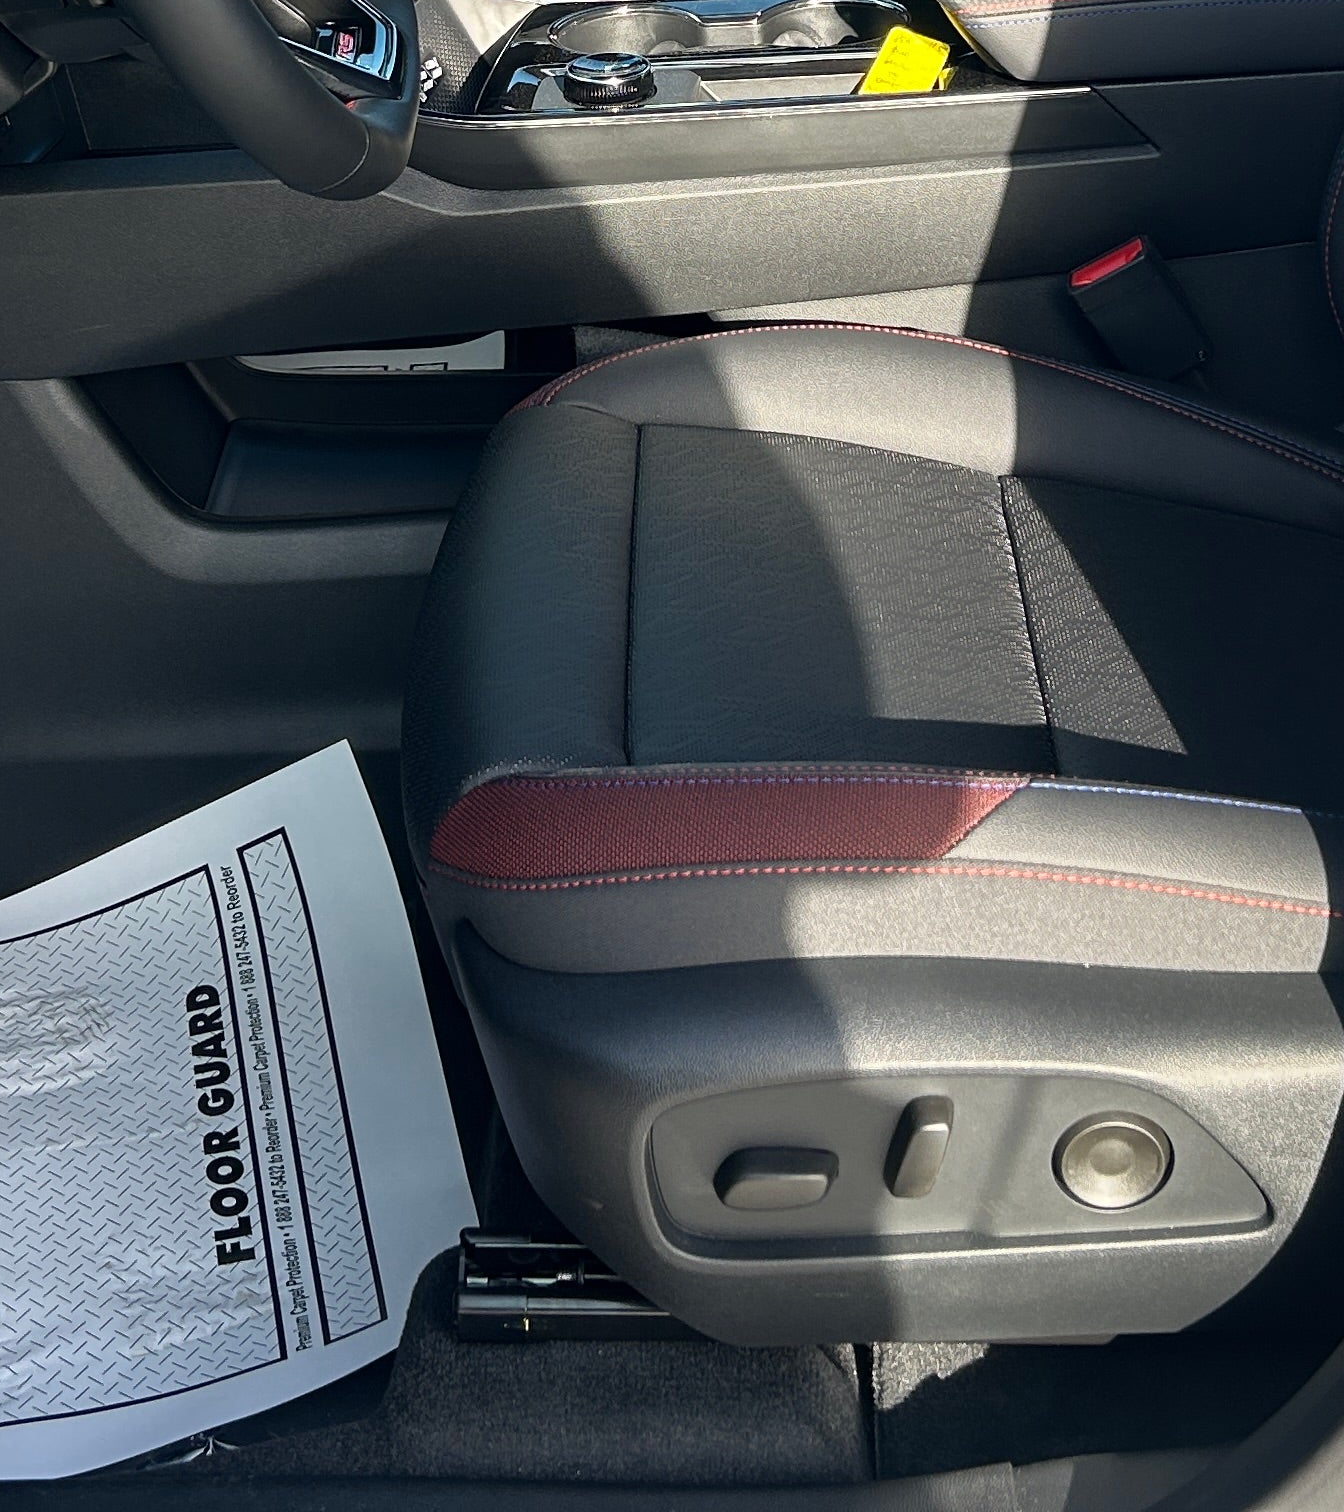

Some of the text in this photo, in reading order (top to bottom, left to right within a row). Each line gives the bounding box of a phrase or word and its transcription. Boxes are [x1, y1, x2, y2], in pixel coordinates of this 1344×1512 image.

[337, 31, 354, 59] RS
[220, 866, 241, 911] Reorder
[231, 911, 244, 922] to
[231, 923, 253, 968] 247-5432
[238, 968, 256, 984] 888
[244, 998, 264, 1043] Protection
[252, 1043, 269, 1071] Carpet
[256, 1072, 273, 1112] Premium
[185, 984, 256, 1266] FLOOR GUARD
[262, 1118, 281, 1153] Reorder
[269, 1165, 290, 1206] 247-5432
[274, 1207, 292, 1222] 888
[281, 1238, 304, 1288] Protection
[290, 1286, 310, 1316] Carpet
[296, 1314, 313, 1352] Premium
